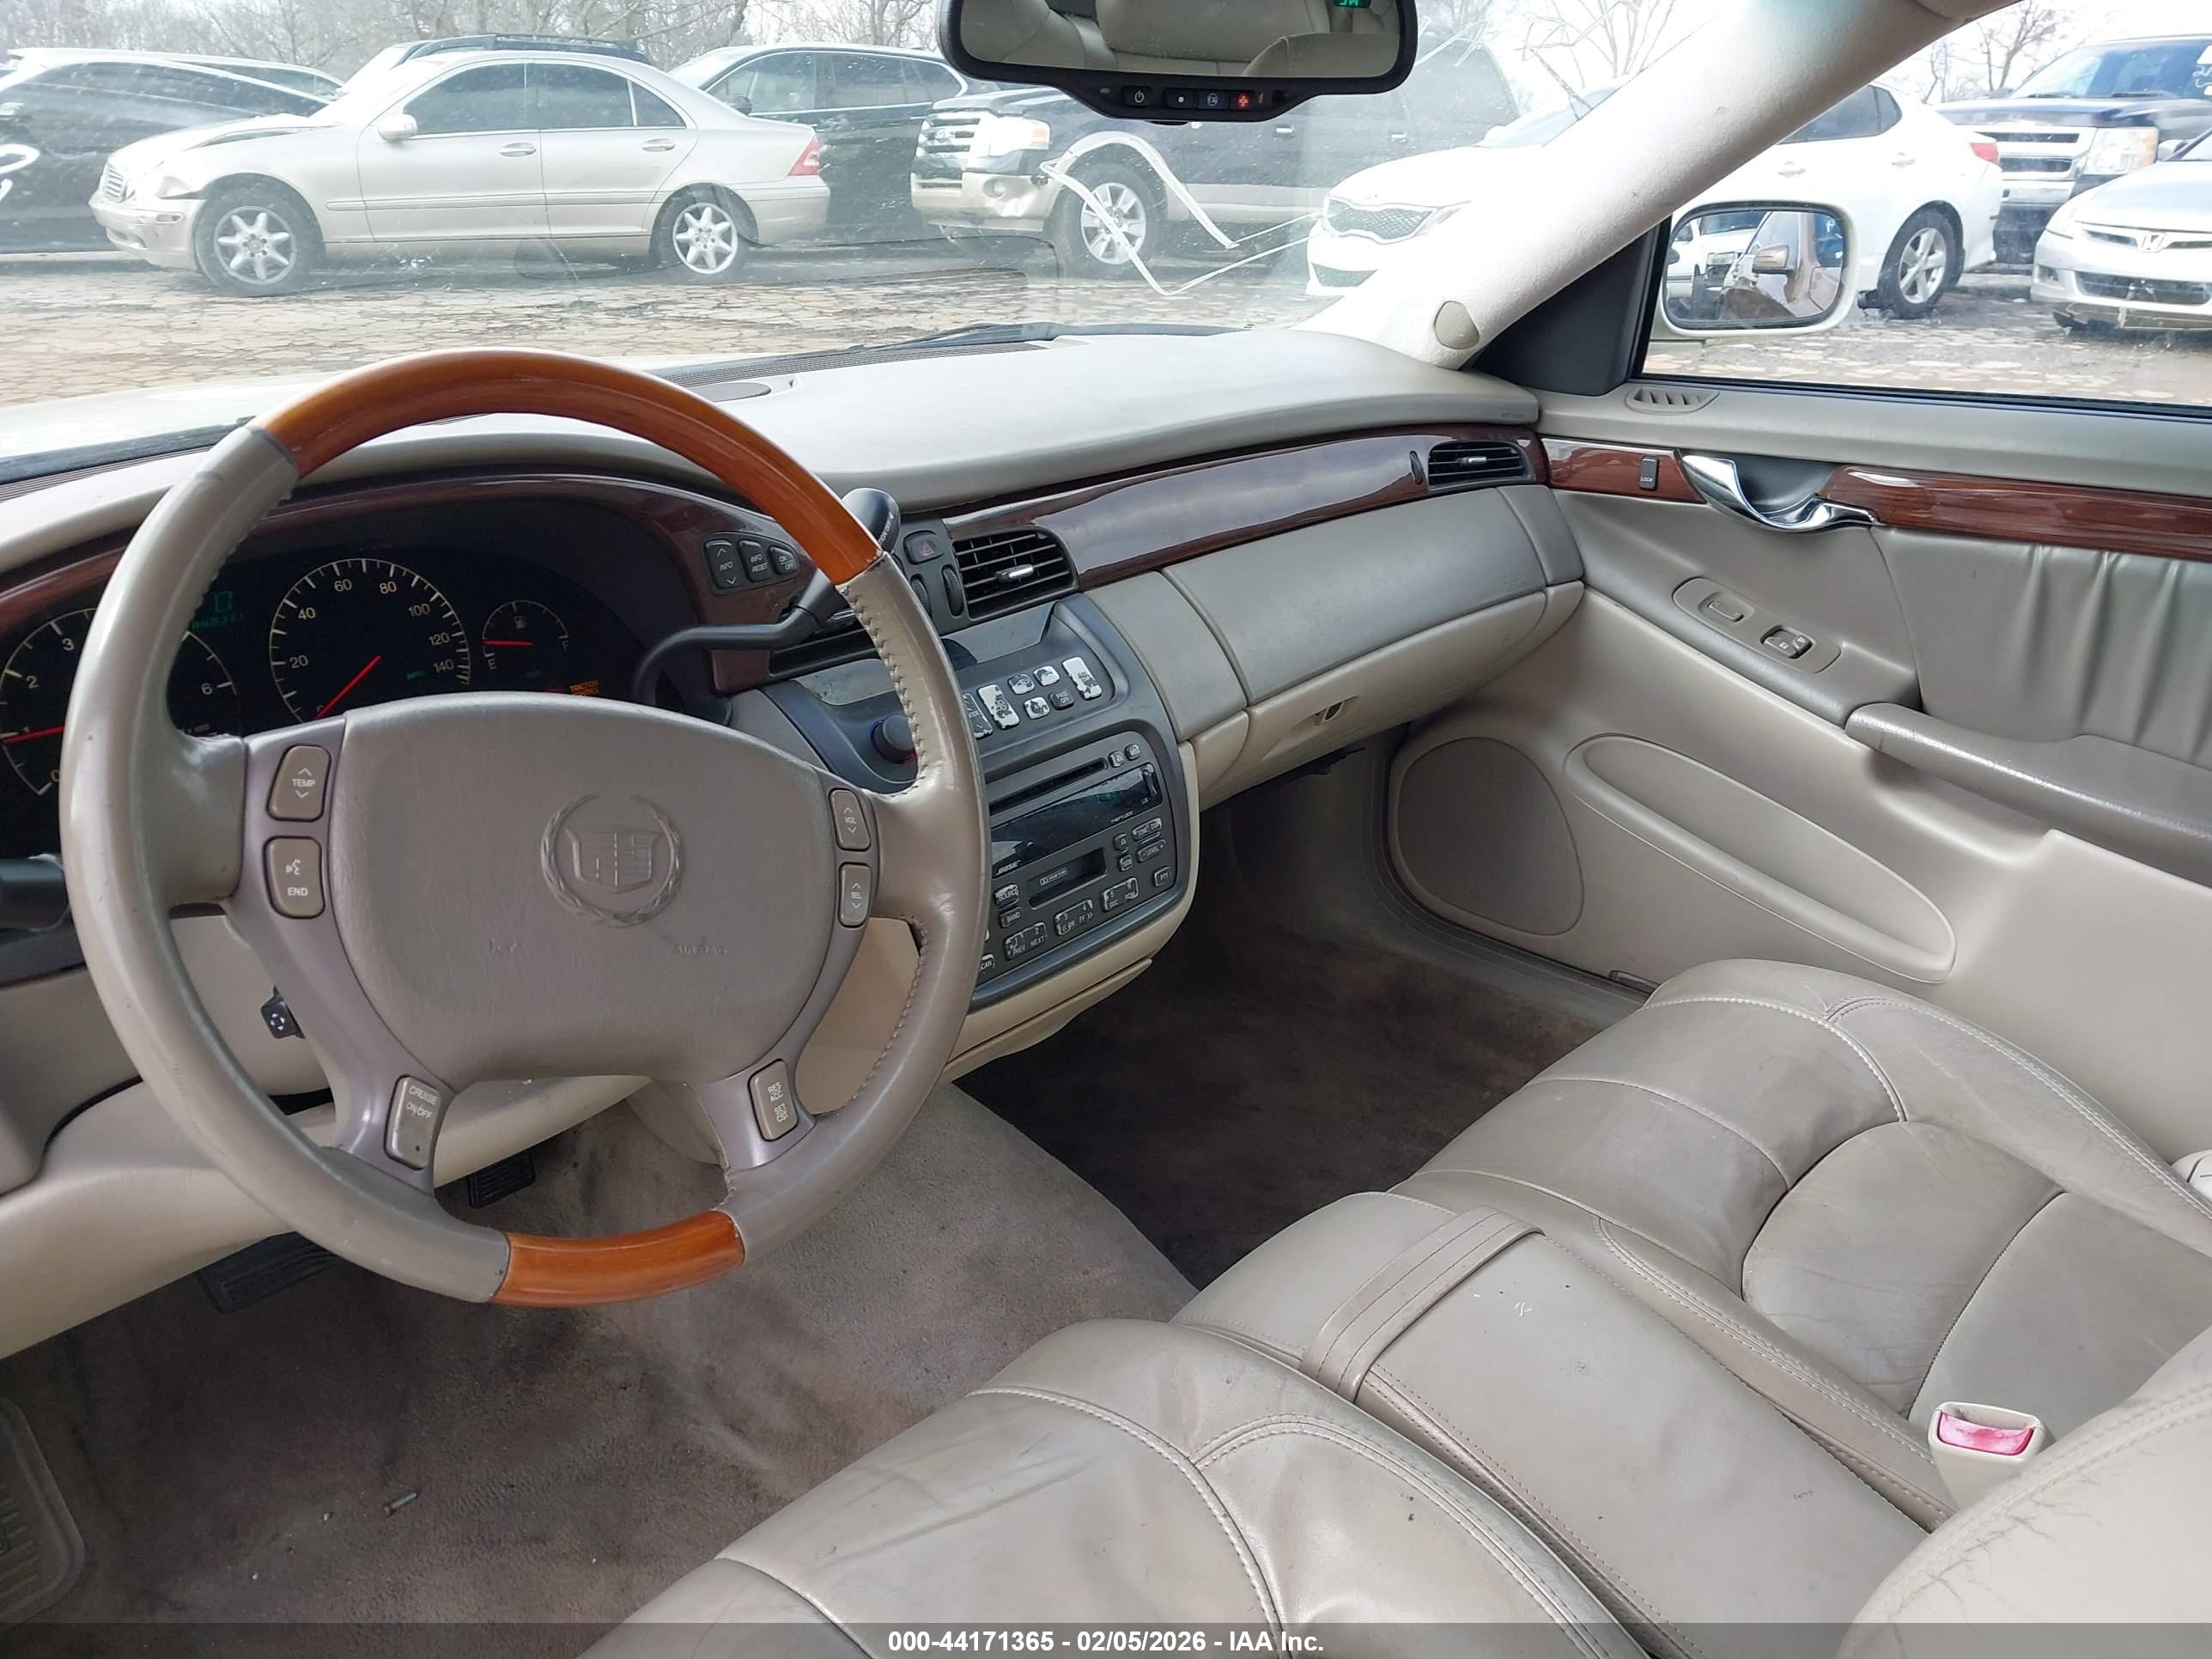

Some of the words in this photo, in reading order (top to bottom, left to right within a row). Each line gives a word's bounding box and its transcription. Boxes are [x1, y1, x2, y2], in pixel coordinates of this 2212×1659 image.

[750, 554, 763, 562] INFO
[720, 562, 733, 571] INFO
[752, 562, 768, 573] RESET
[334, 579, 353, 592] 60
[379, 580, 398, 594] 80
[297, 607, 316, 620] 40
[408, 603, 430, 617] 100
[62, 638, 75, 651] 3
[429, 632, 451, 646] 120
[289, 655, 308, 669] 20
[433, 659, 454, 673] 140
[488, 659, 497, 670] E
[27, 675, 39, 689] 2
[201, 683, 214, 695] 6
[291, 778, 316, 787] TEMP
[1146, 846, 1159, 856] LEVEL
[996, 860, 1021, 875] BOSE
[288, 887, 308, 896] END
[1006, 911, 1021, 923] BAND
[1034, 927, 1039, 935] 2
[1030, 935, 1045, 947] NEXT
[1013, 944, 1026, 956] PREV
[768, 1082, 781, 1094] RES
[409, 1085, 438, 1106] CRUISE
[770, 1091, 783, 1102] ACC
